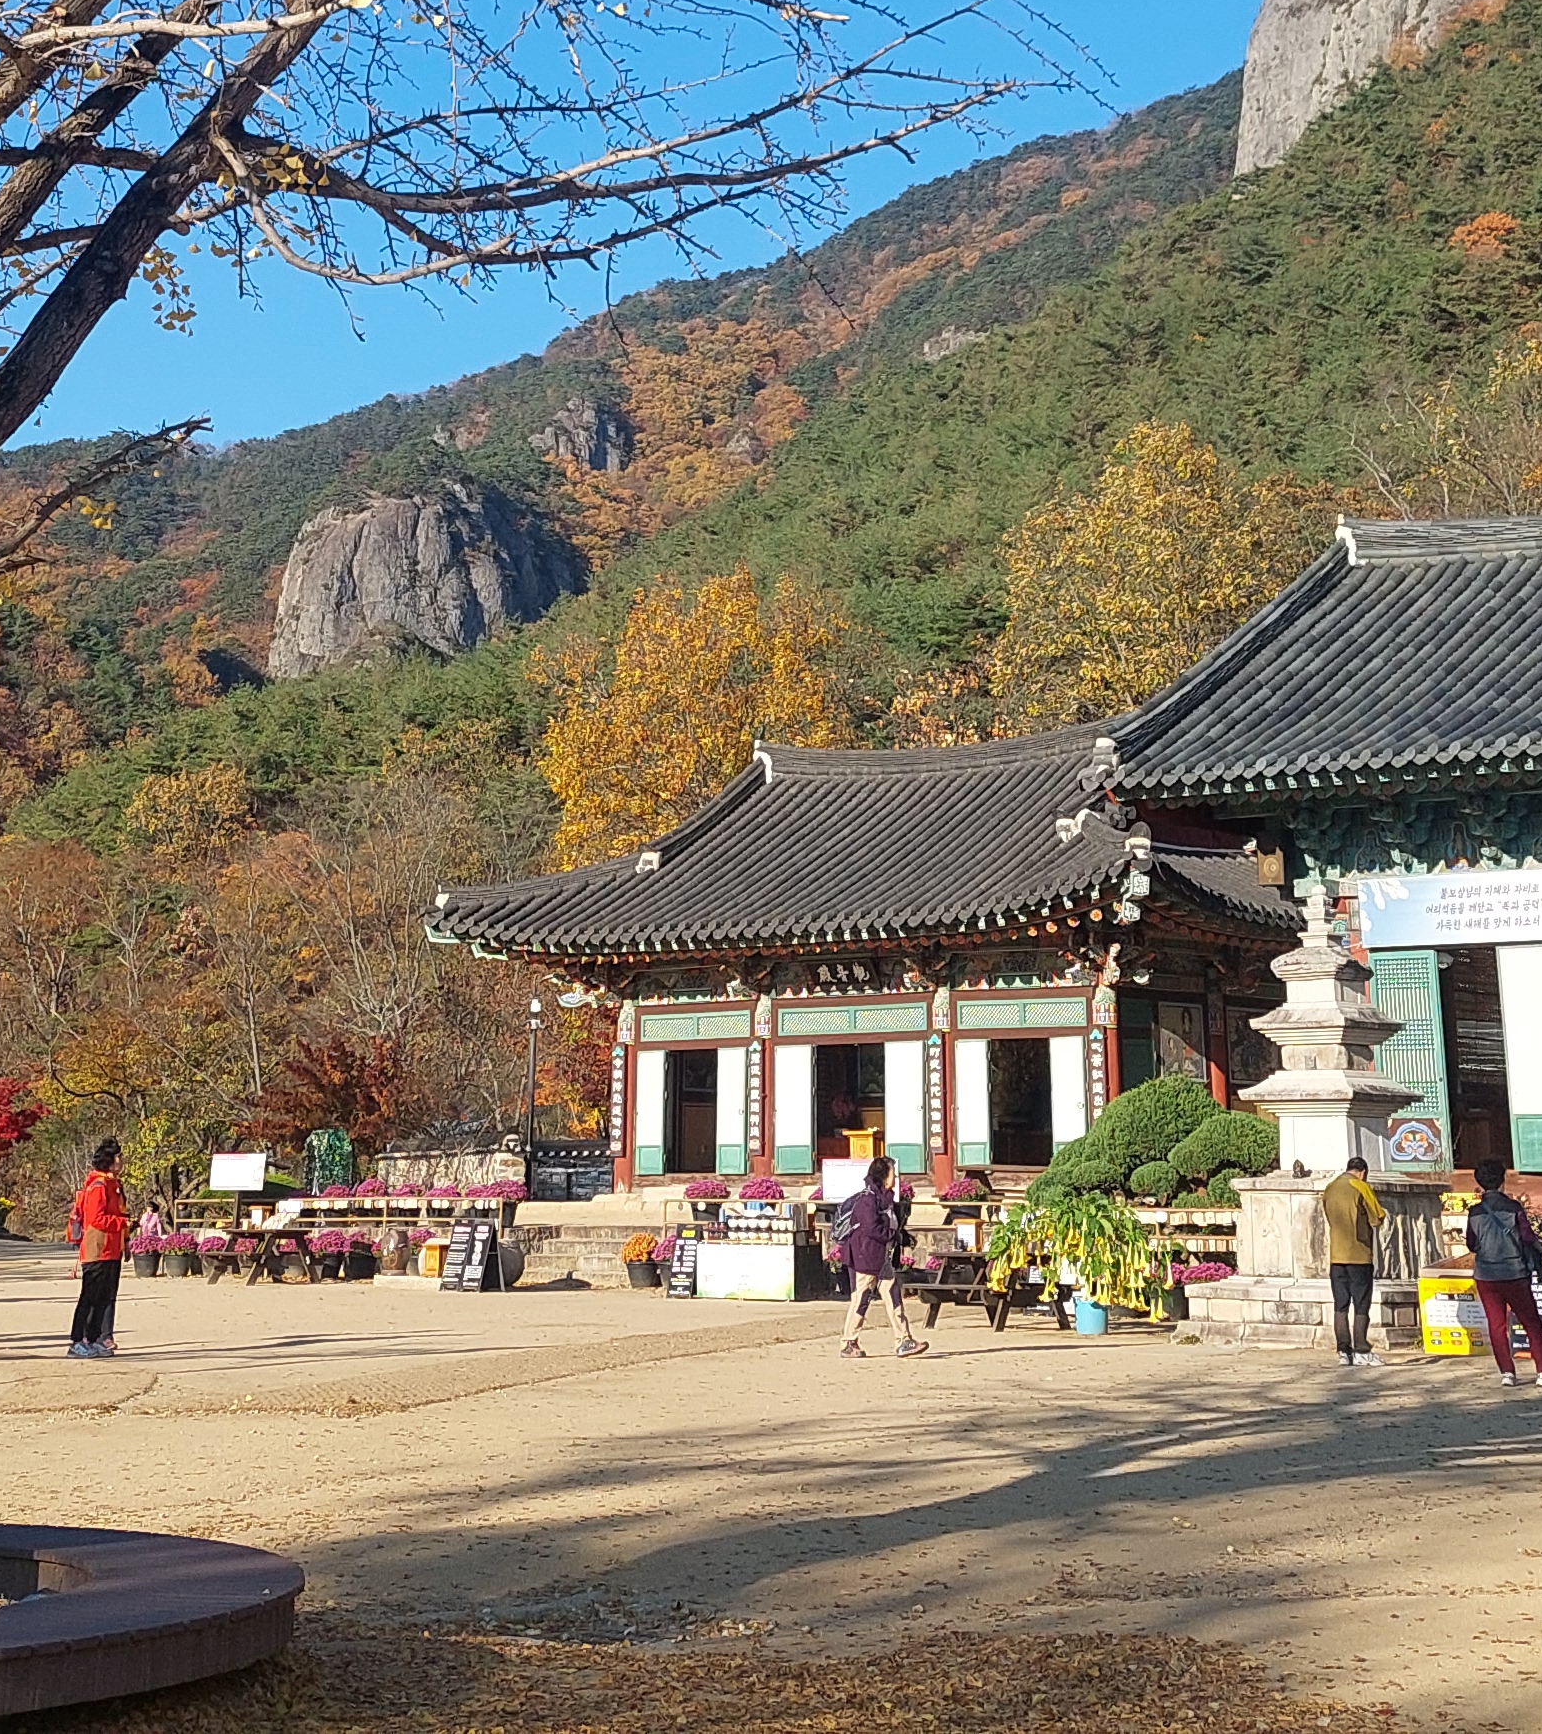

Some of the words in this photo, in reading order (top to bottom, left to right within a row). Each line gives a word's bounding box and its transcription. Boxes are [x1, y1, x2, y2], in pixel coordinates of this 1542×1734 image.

[1484, 883, 1511, 897] 지혜와
[1514, 882, 1540, 894] 자비로
[1435, 917, 1462, 931] 가득한
[1463, 916, 1490, 930] 새해를
[1514, 915, 1541, 928] 하소서
